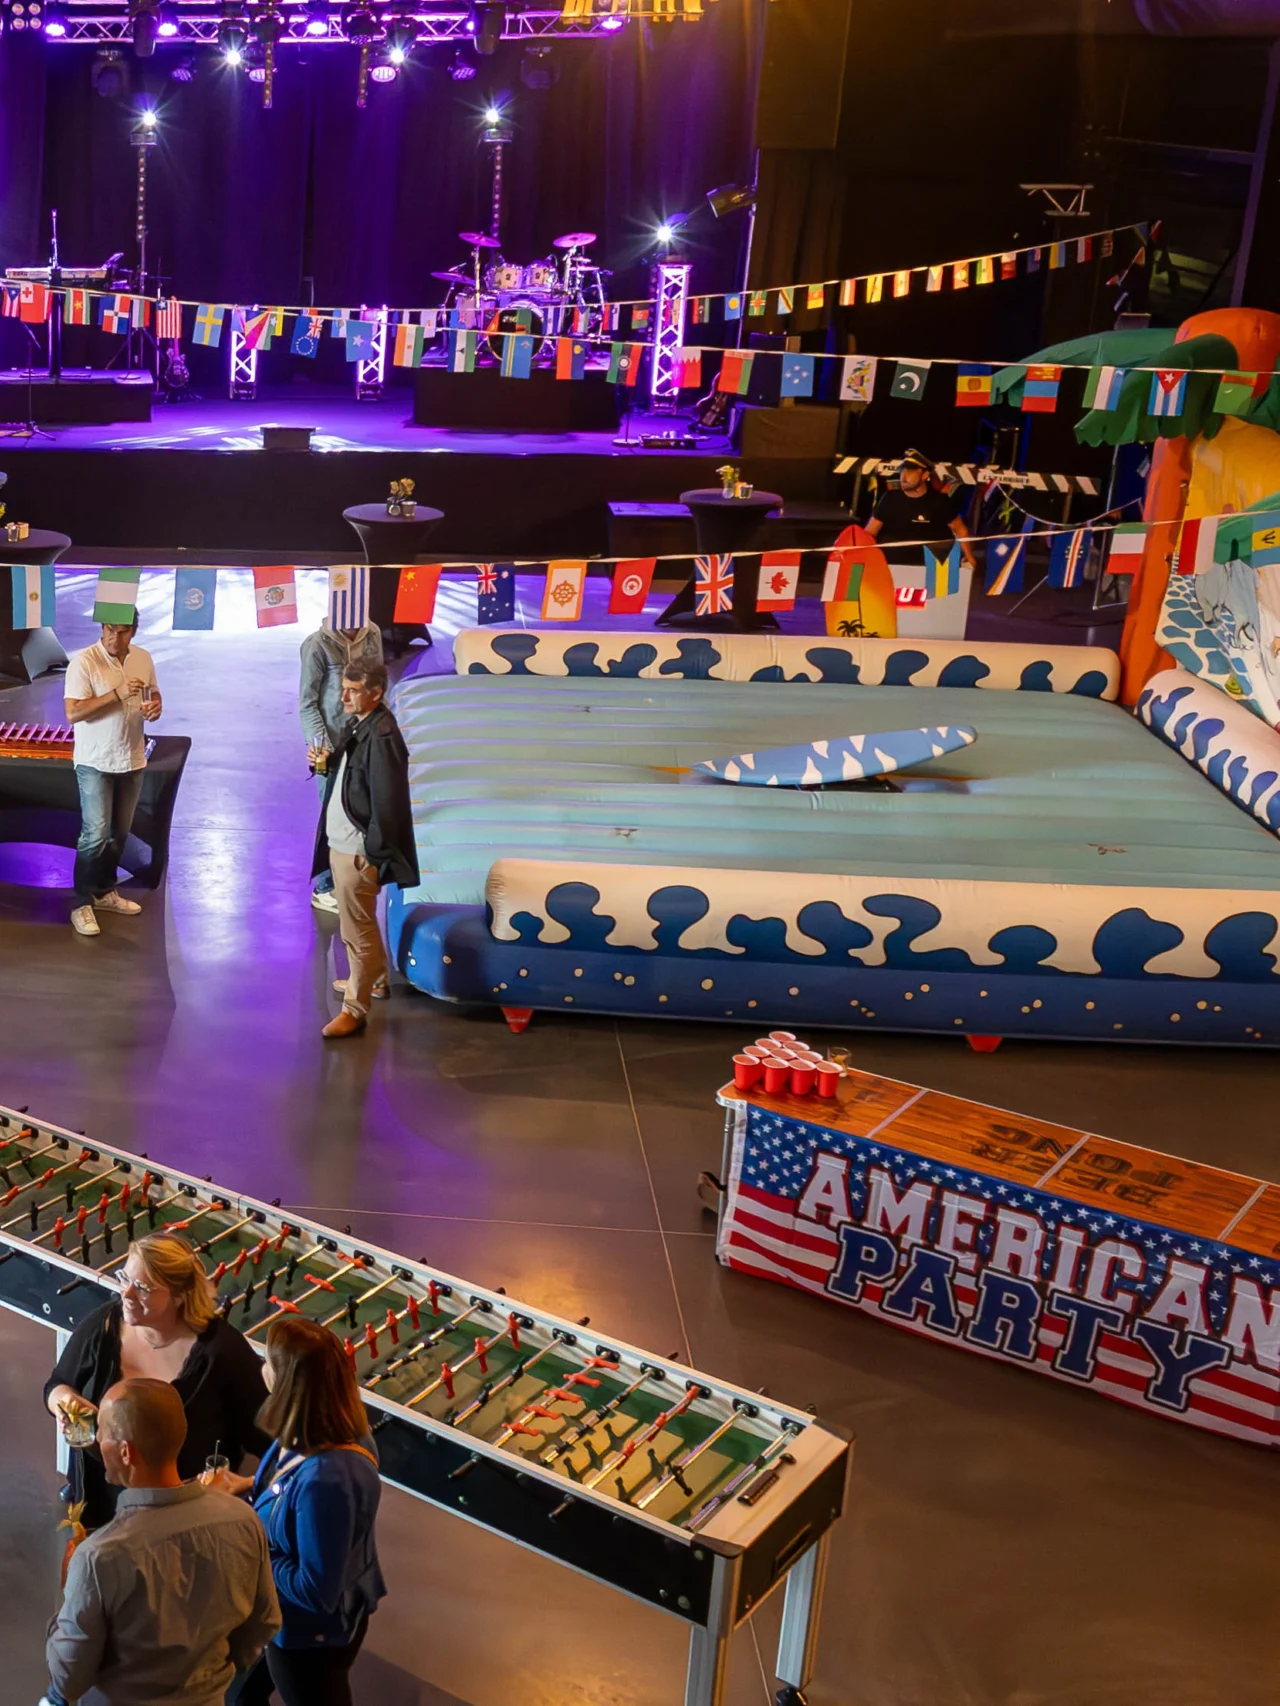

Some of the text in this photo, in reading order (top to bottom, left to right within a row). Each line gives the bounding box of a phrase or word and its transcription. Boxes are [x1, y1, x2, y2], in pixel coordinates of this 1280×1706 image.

[969, 1138, 1170, 1208] BEER
[988, 1123, 1184, 1190] PONG
[796, 1152, 1280, 1373] AMERICAN
[825, 1222, 1232, 1412] PARTY
